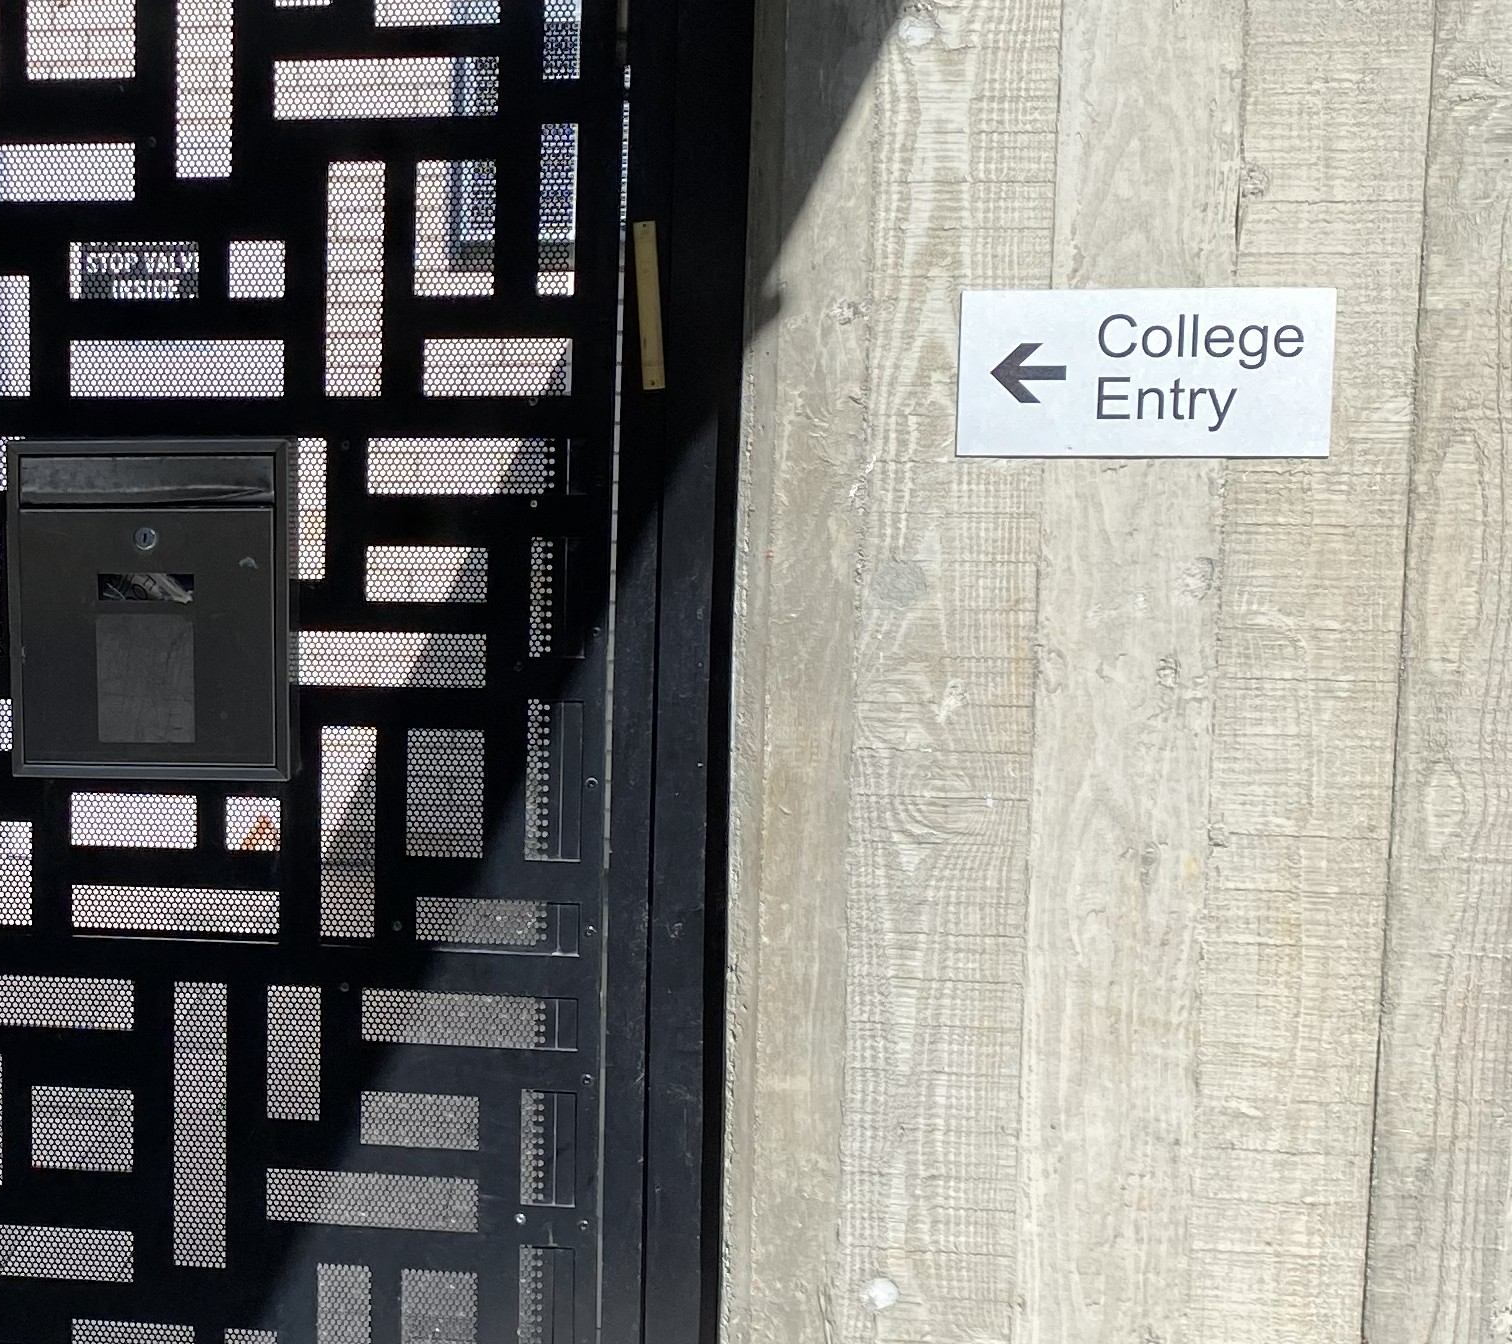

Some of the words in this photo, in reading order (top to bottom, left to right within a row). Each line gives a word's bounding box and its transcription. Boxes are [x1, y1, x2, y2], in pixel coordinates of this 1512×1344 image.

[86, 252, 139, 273] STOP
[112, 279, 181, 299] INSIDE
[1098, 313, 1305, 370] College
[1096, 376, 1238, 432] Entry
